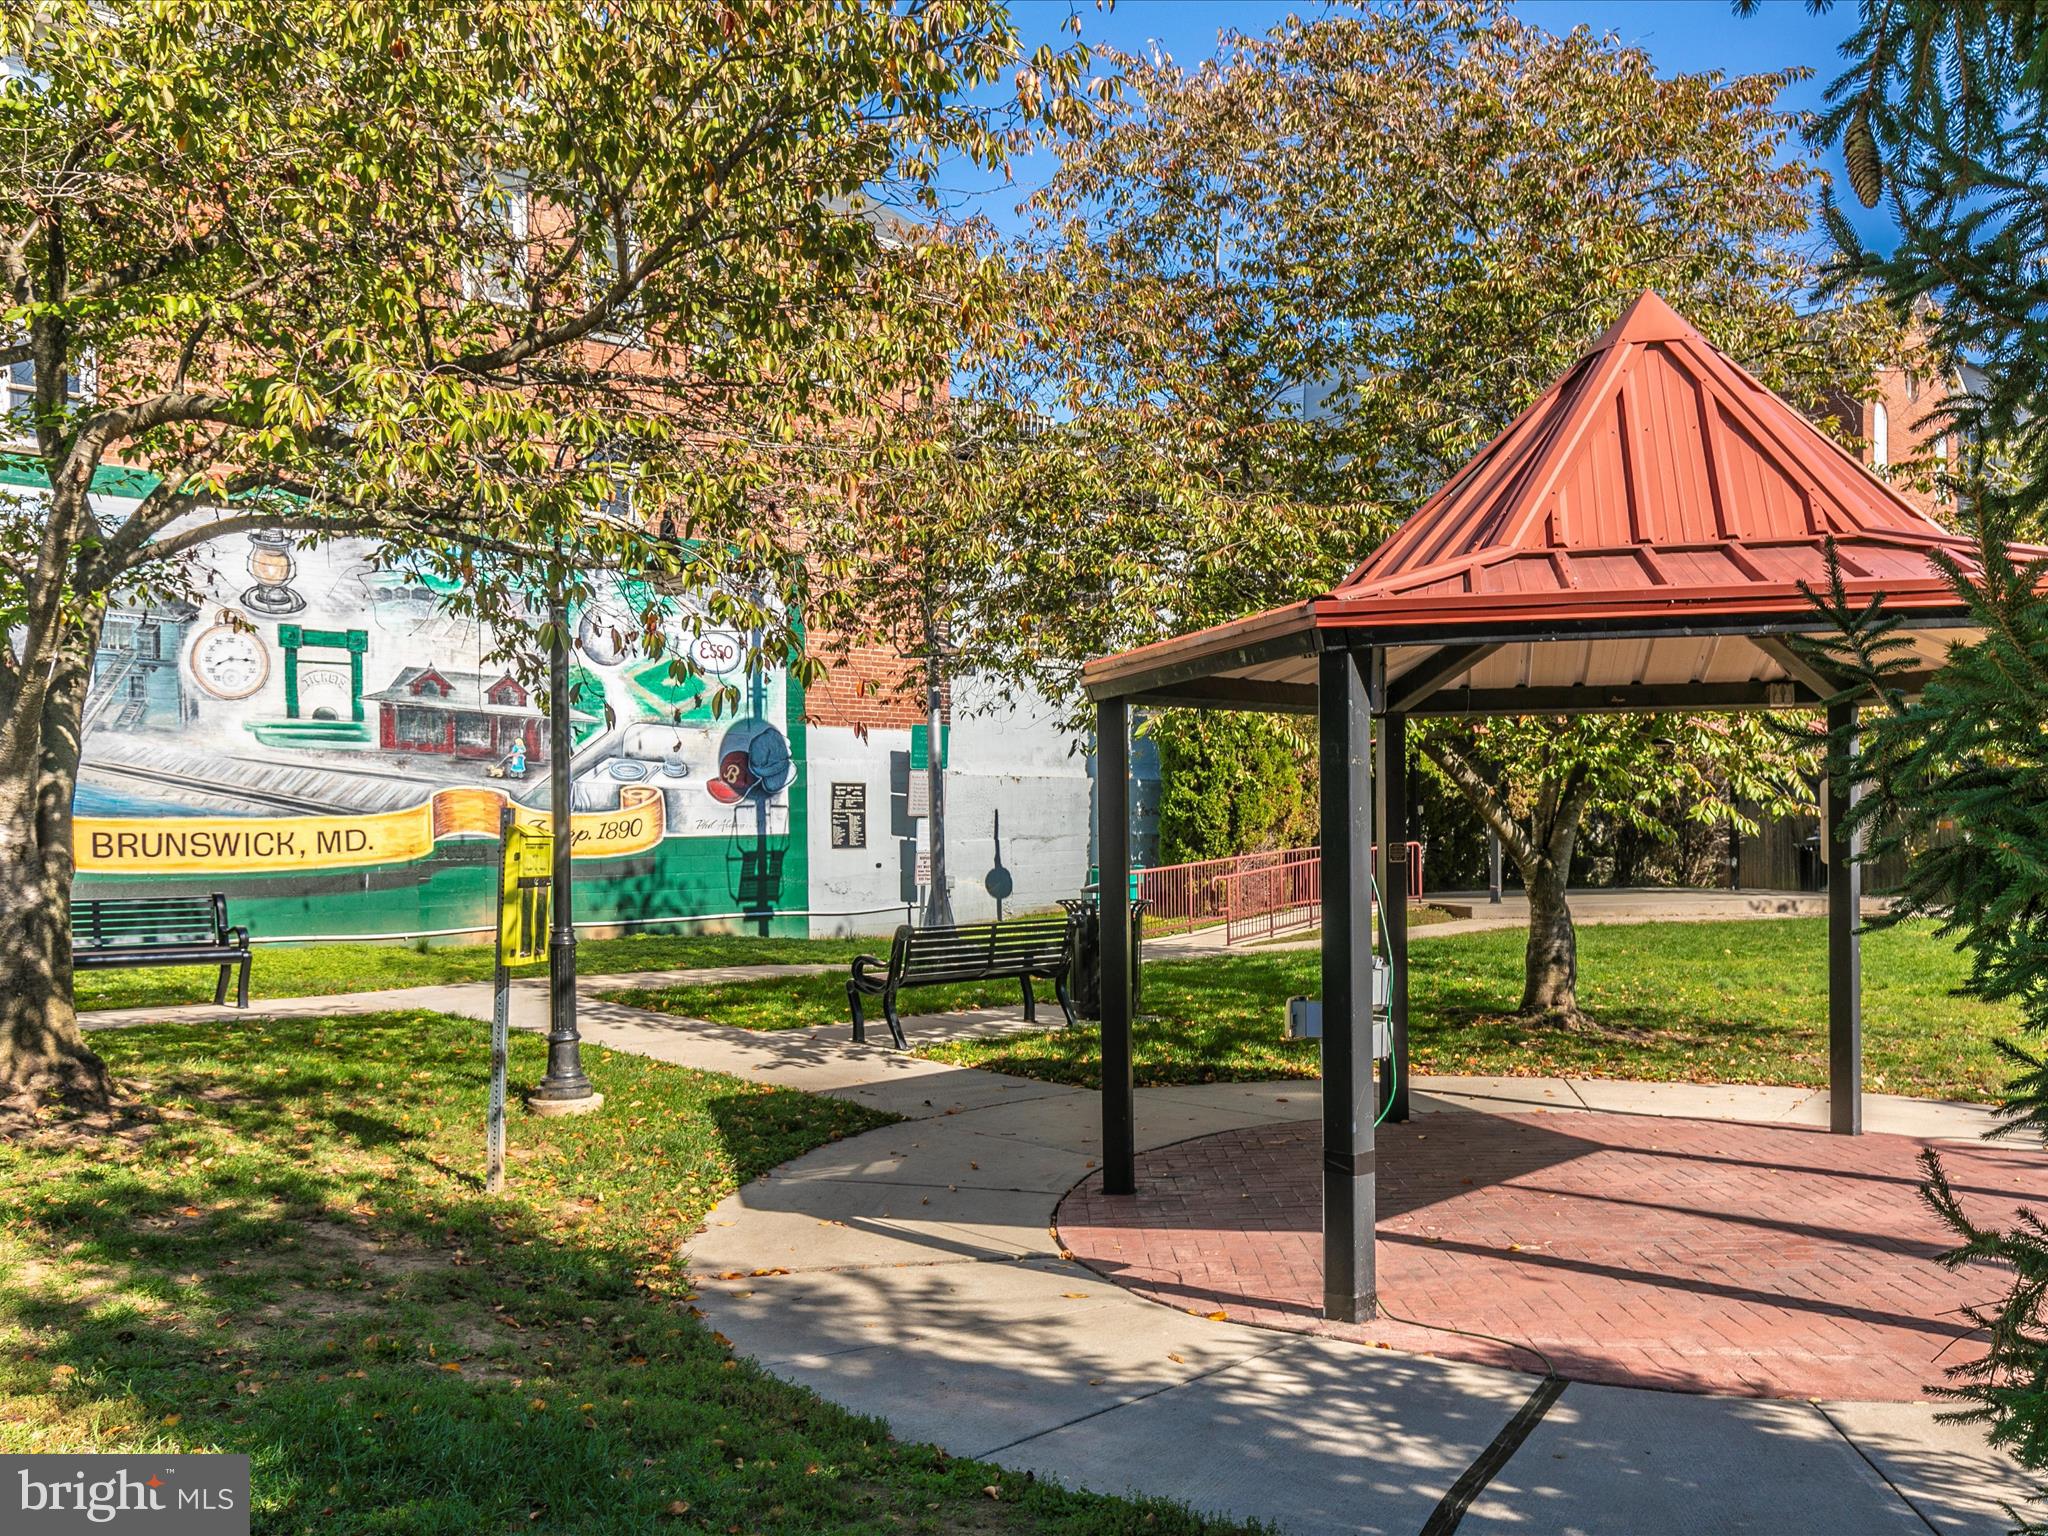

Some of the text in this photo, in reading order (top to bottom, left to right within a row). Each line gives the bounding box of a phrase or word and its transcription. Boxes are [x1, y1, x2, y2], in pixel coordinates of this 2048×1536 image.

[723, 764, 740, 784] B
[596, 818, 643, 839] 1890
[91, 829, 374, 858] BRUNSWICK, MD.
